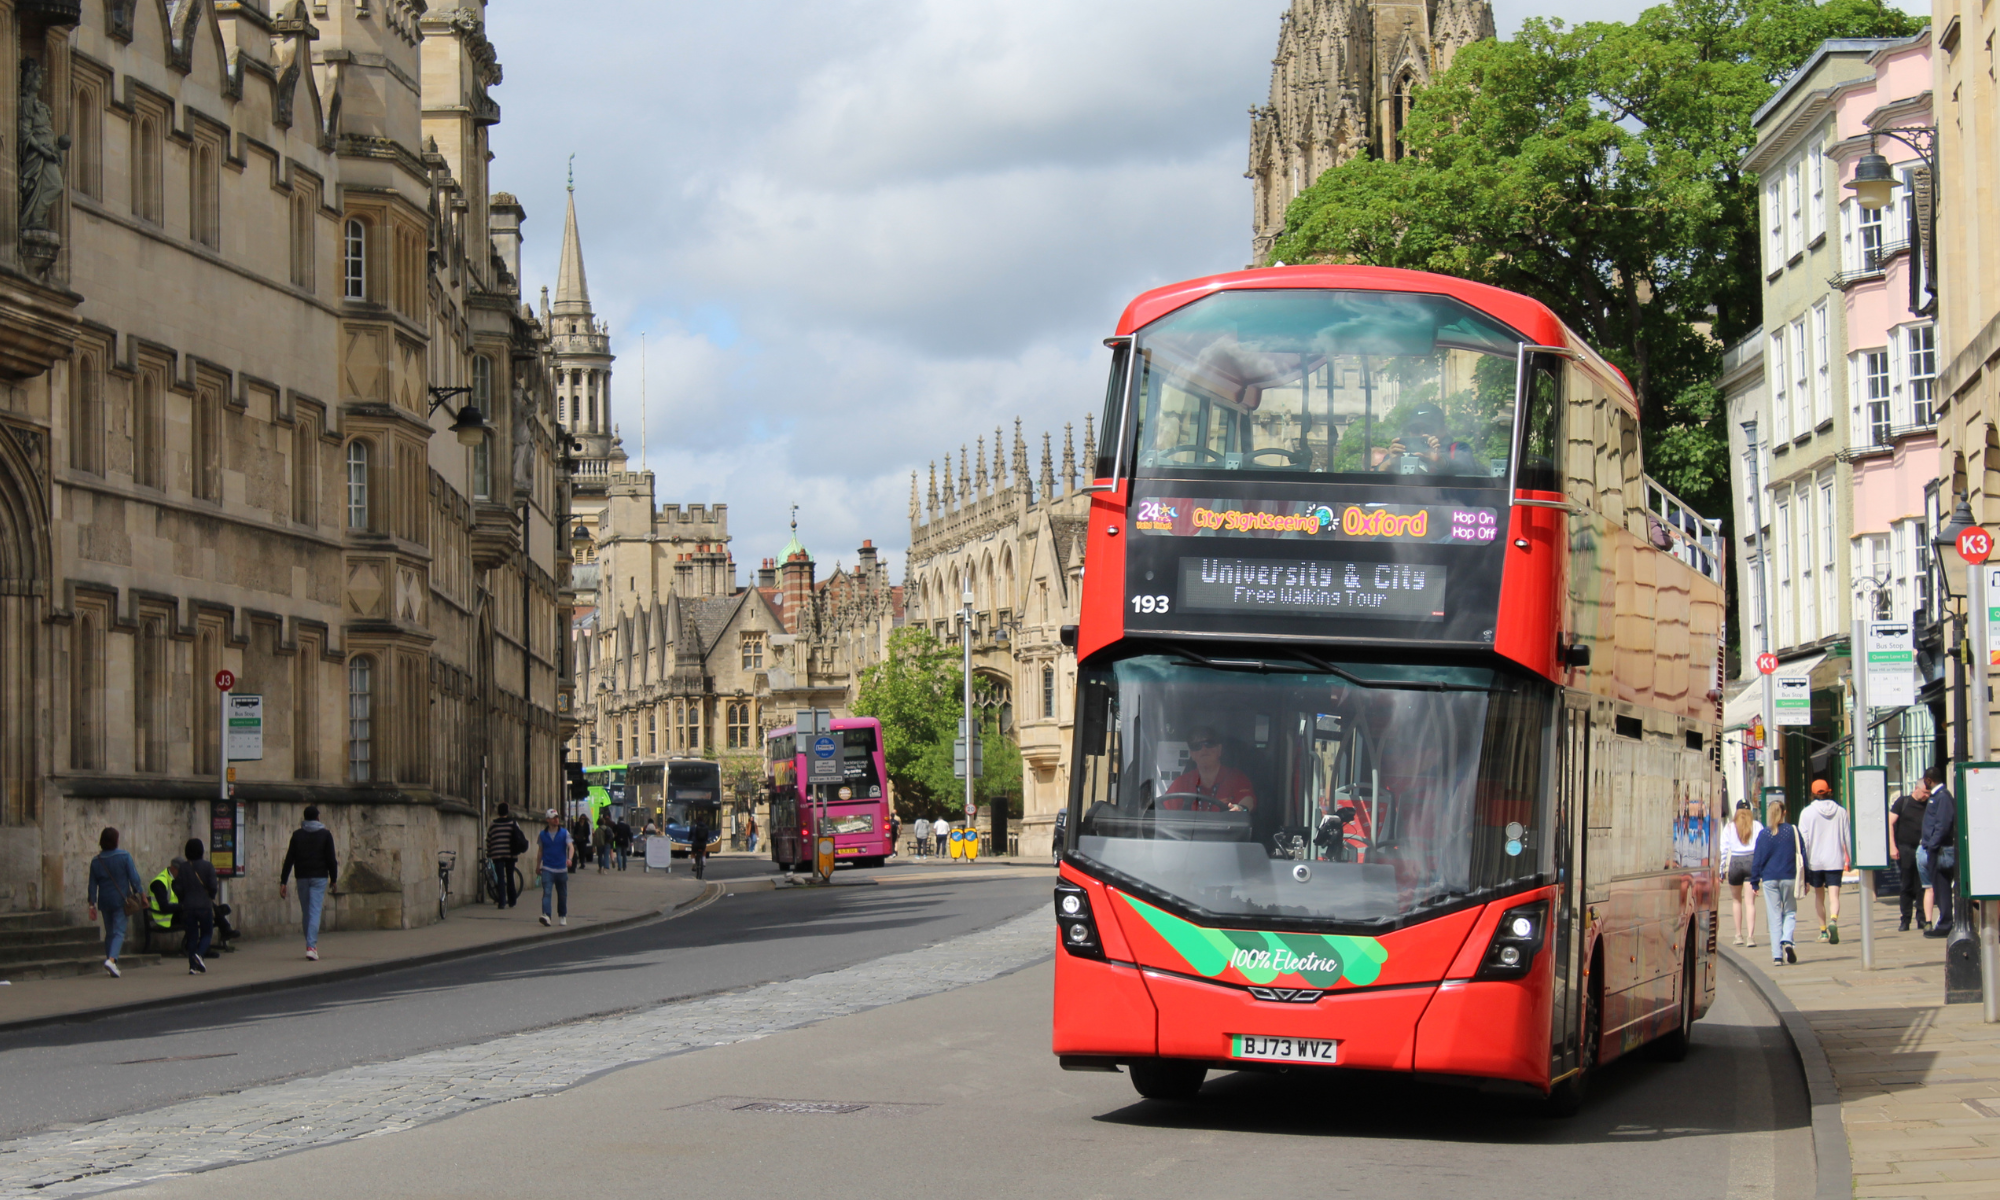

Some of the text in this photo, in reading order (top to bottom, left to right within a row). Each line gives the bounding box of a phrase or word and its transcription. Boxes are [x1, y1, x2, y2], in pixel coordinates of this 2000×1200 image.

[1137, 501, 1159, 521] 24
[1453, 511, 1495, 525] Hop On
[1343, 506, 1427, 536] Oxford
[1452, 526, 1497, 540] Hop Off
[1962, 535, 1988, 554] K3
[1201, 559, 1425, 590] University & City
[1131, 595, 1170, 614] 193
[1234, 586, 1388, 607] Free Walking Tour
[1889, 642, 1904, 650] Stop
[1760, 657, 1775, 669] K1
[219, 675, 231, 686] J3
[1230, 948, 1337, 972] 100% Electric
[1245, 1037, 1332, 1058] BJ73 WVZ
